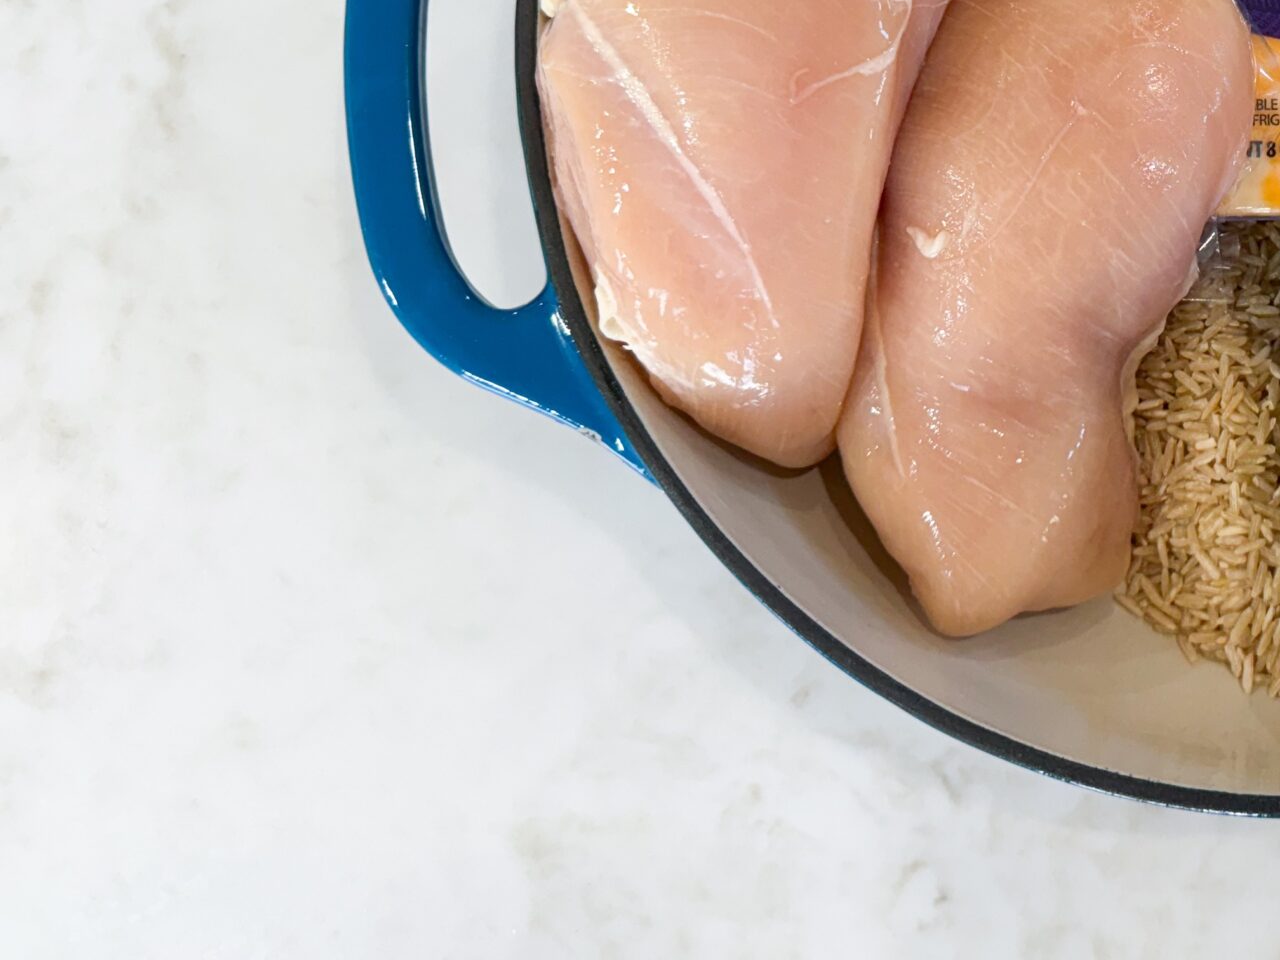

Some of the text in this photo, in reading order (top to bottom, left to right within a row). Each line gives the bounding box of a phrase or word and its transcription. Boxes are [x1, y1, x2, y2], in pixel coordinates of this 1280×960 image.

[1255, 99, 1278, 110] BLE
[1247, 141, 1262, 157] T
[1266, 142, 1276, 157] 8
